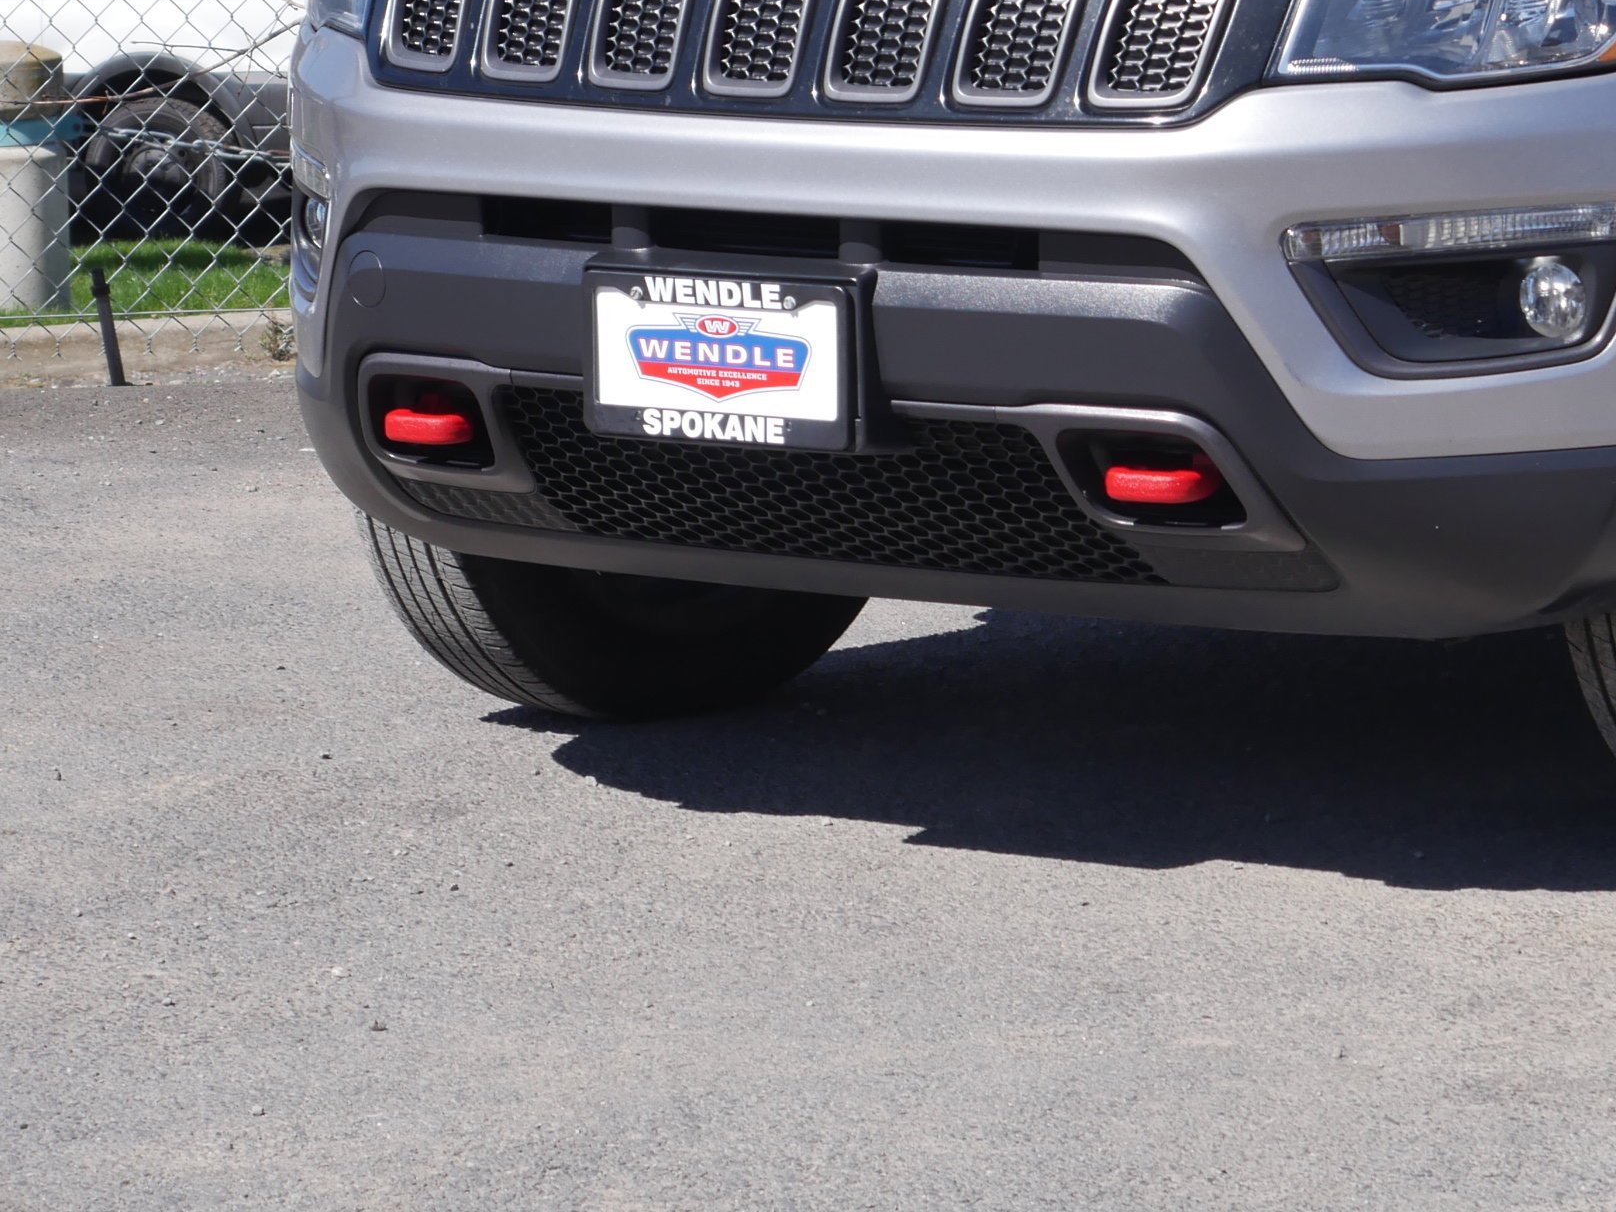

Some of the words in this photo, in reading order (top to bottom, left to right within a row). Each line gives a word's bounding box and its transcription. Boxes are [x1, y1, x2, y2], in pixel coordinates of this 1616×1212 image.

[644, 276, 782, 310] WENDLE
[638, 338, 794, 368] WENDLE
[667, 366, 717, 377] AUTOMOTIVE
[718, 370, 768, 381] EXCELLENCE
[696, 377, 720, 386] SINCE
[721, 379, 740, 387] 1943
[642, 408, 785, 444] SPOKANE
